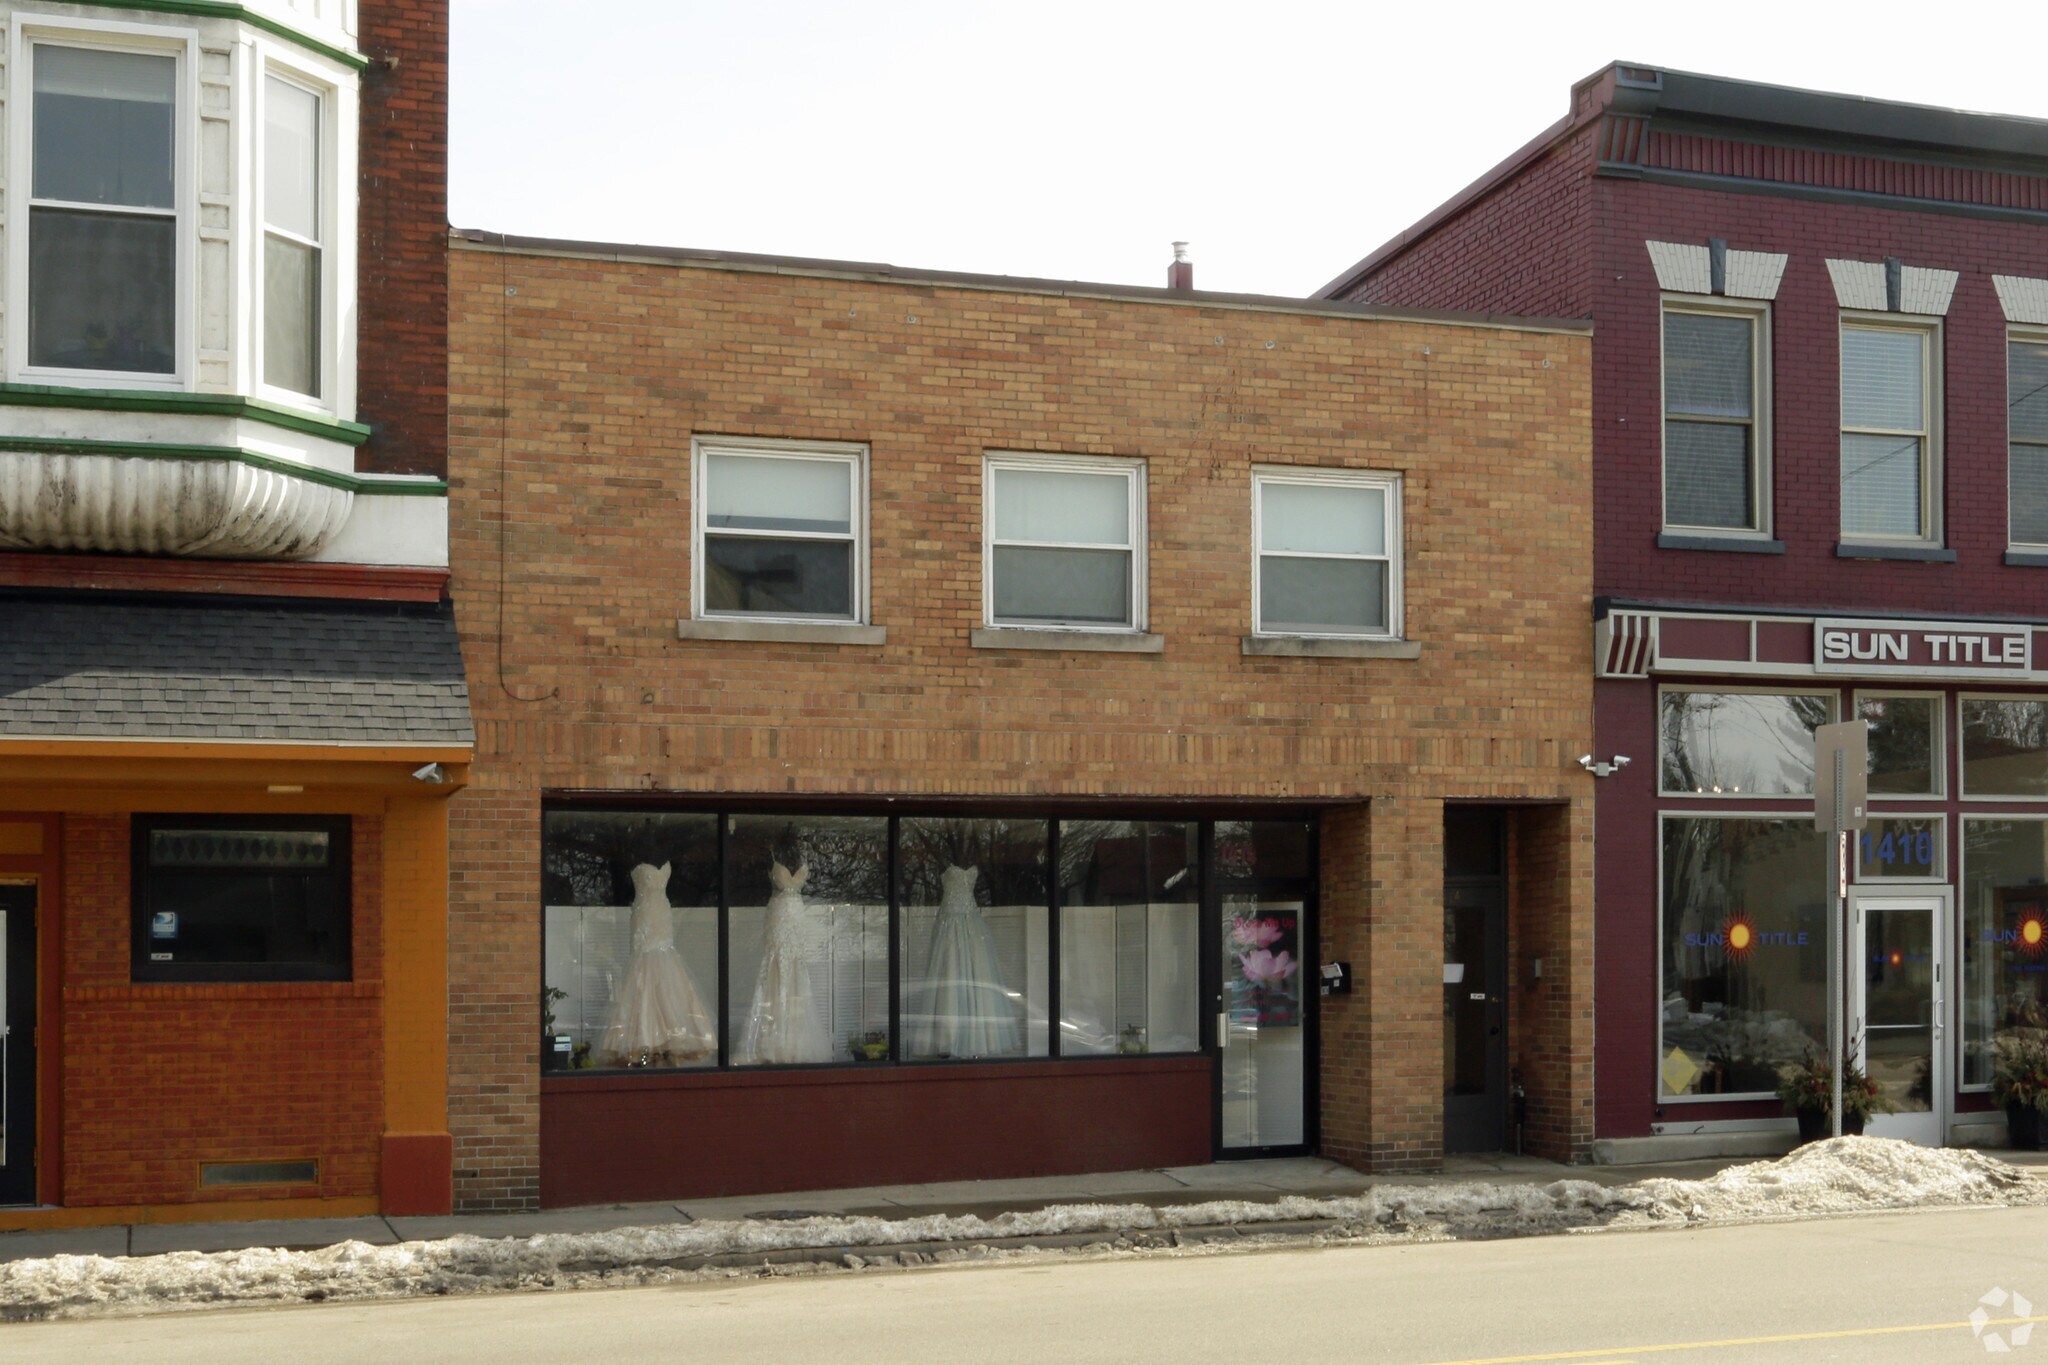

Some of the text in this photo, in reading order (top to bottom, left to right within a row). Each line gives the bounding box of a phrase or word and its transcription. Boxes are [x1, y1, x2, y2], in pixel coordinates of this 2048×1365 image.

[1823, 631, 2025, 664] SUN TITLE
[1860, 831, 1933, 865] 1410
[1684, 931, 1809, 946] SUN TITLE
